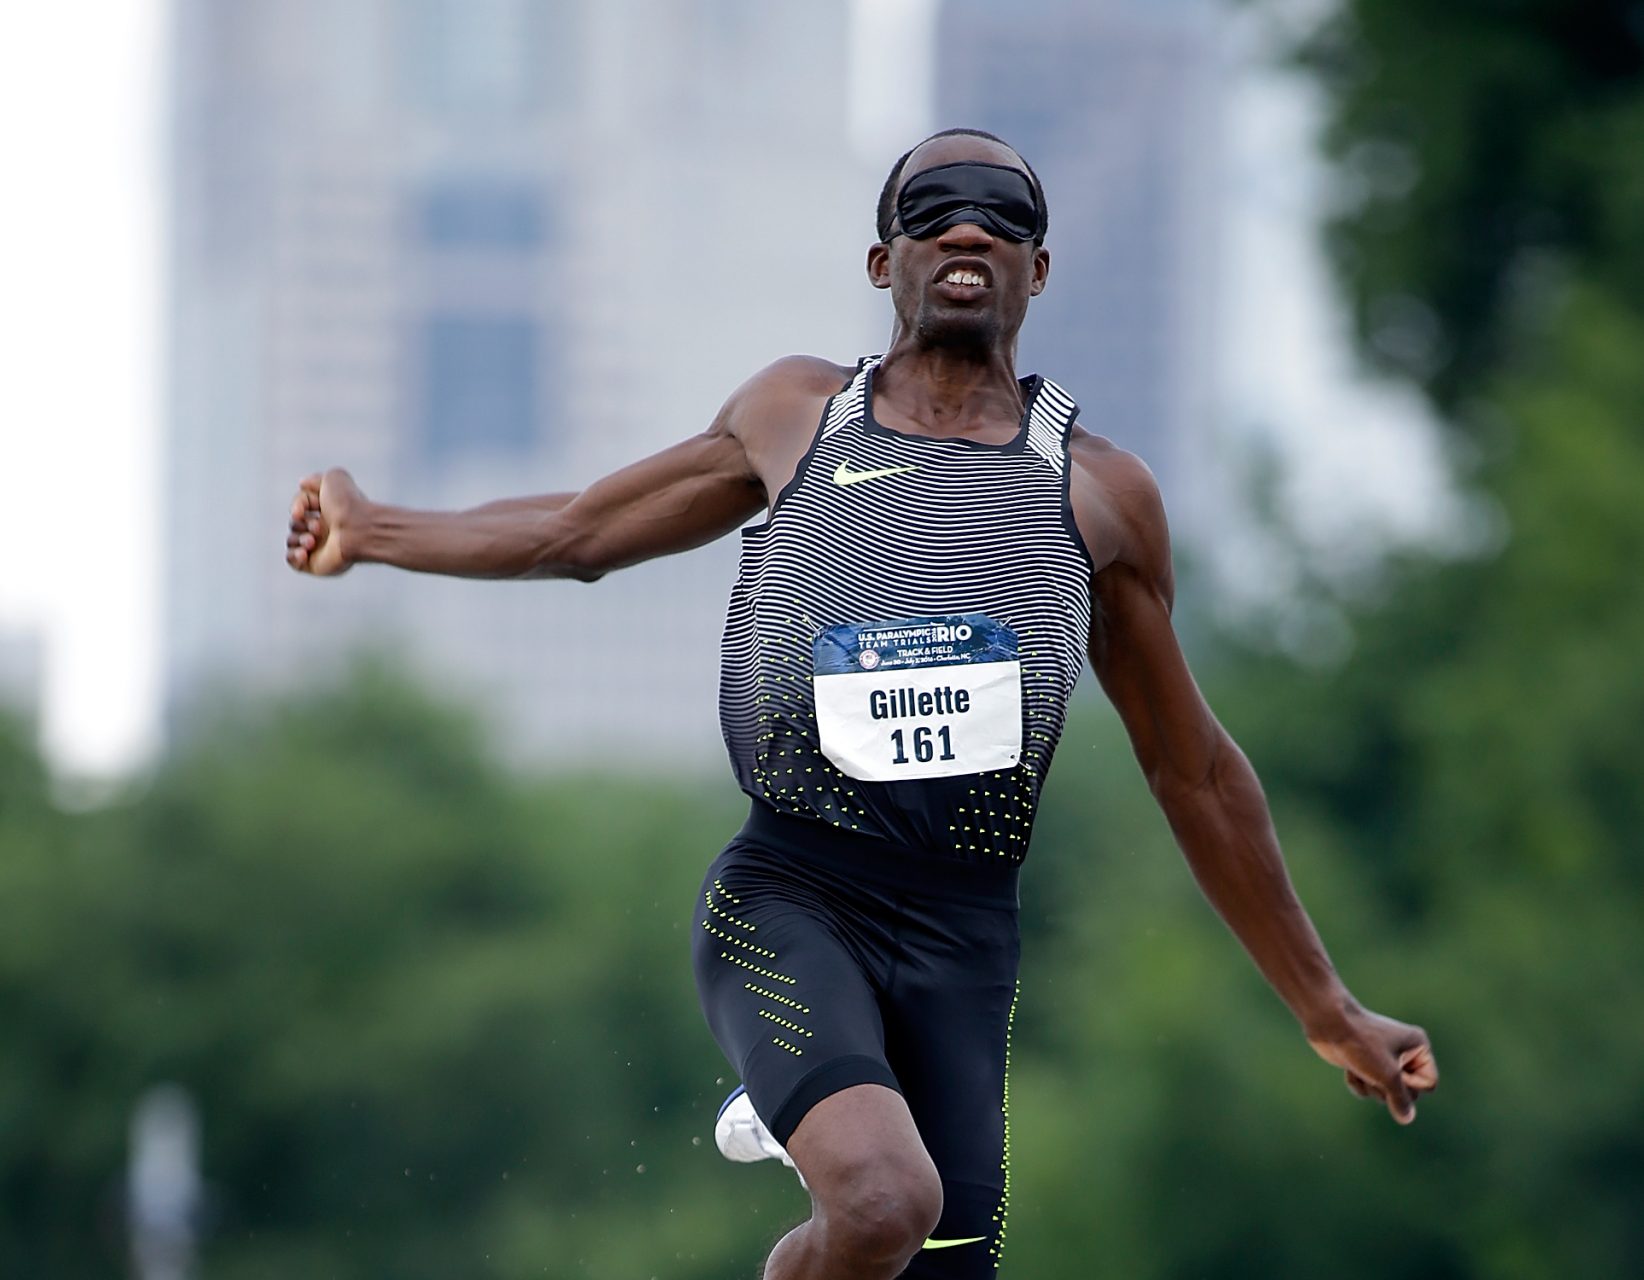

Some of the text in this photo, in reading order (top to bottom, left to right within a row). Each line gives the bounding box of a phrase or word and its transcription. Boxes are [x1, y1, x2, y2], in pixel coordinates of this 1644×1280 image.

[858, 628, 931, 641] U.S. PARALYMPIC
[937, 625, 972, 642] RIO
[859, 637, 931, 649] TEAM TRIALS
[897, 645, 953, 657] TRACK & FIELD
[869, 686, 970, 720] Gillette
[891, 725, 956, 765] 161
